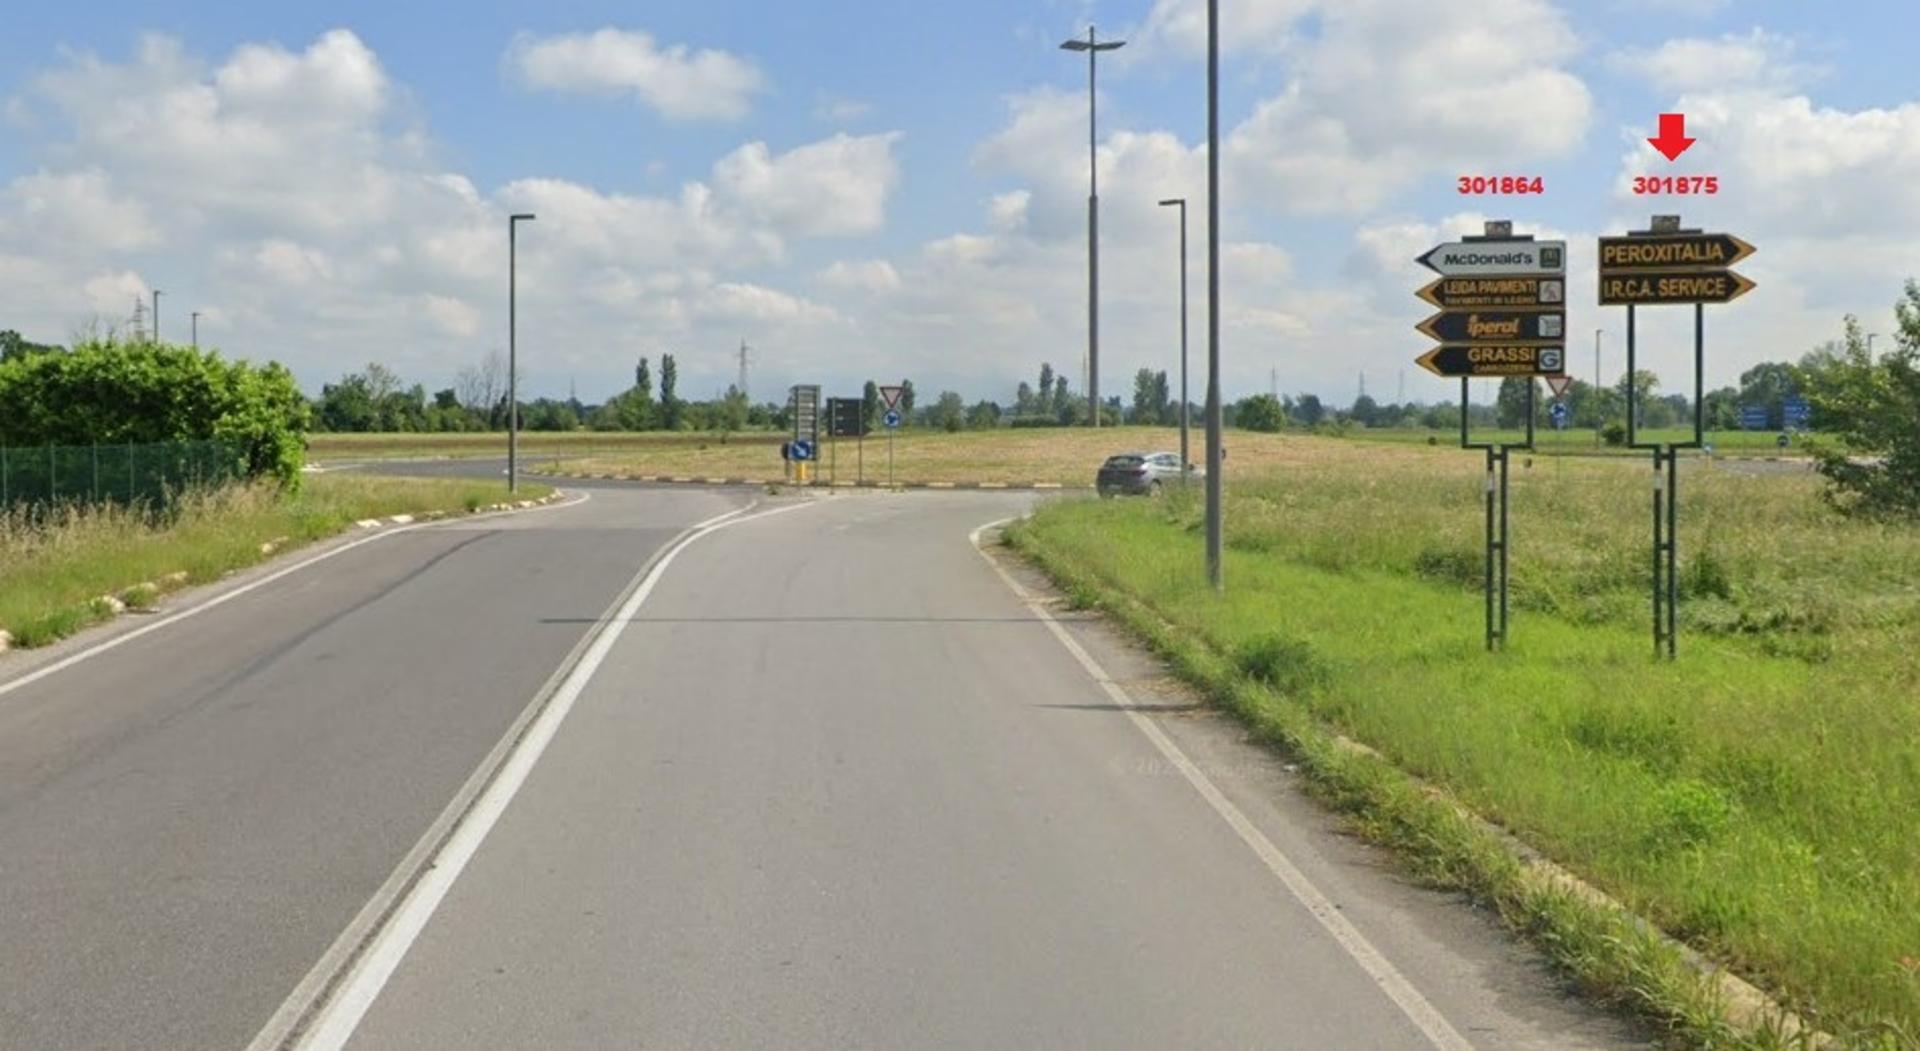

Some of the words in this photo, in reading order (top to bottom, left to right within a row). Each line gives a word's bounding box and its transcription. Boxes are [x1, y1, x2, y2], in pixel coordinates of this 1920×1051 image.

[1445, 253, 1533, 265] McDonald's
[1604, 243, 1723, 263] PEROXITALIA
[1604, 279, 1654, 298] I.R.C.A.
[1658, 278, 1725, 296] SERVICE
[1467, 348, 1535, 362] GRASSI
